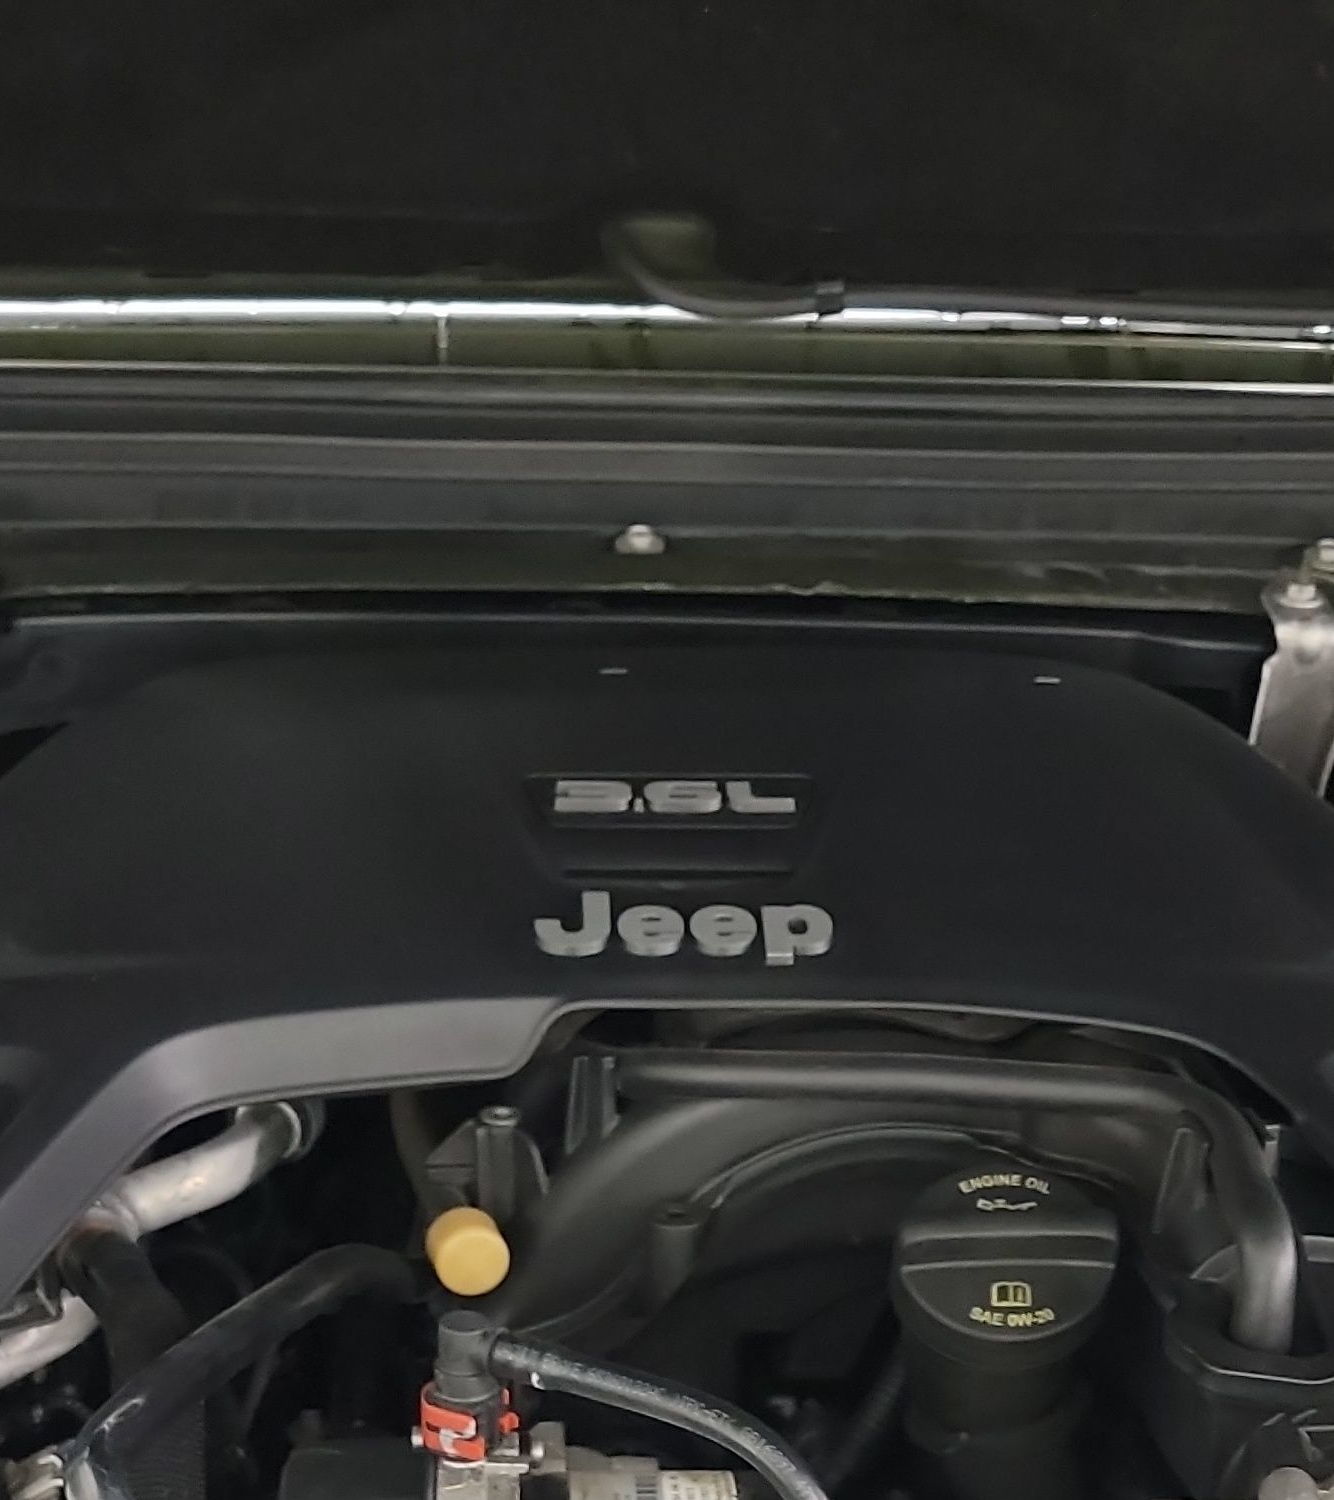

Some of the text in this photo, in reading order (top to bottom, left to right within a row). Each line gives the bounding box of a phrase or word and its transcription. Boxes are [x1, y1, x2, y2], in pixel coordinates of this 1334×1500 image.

[533, 889, 834, 966] Jeep
[957, 1174, 1051, 1195] ENGINE OIL
[969, 1306, 1005, 1326] SAE
